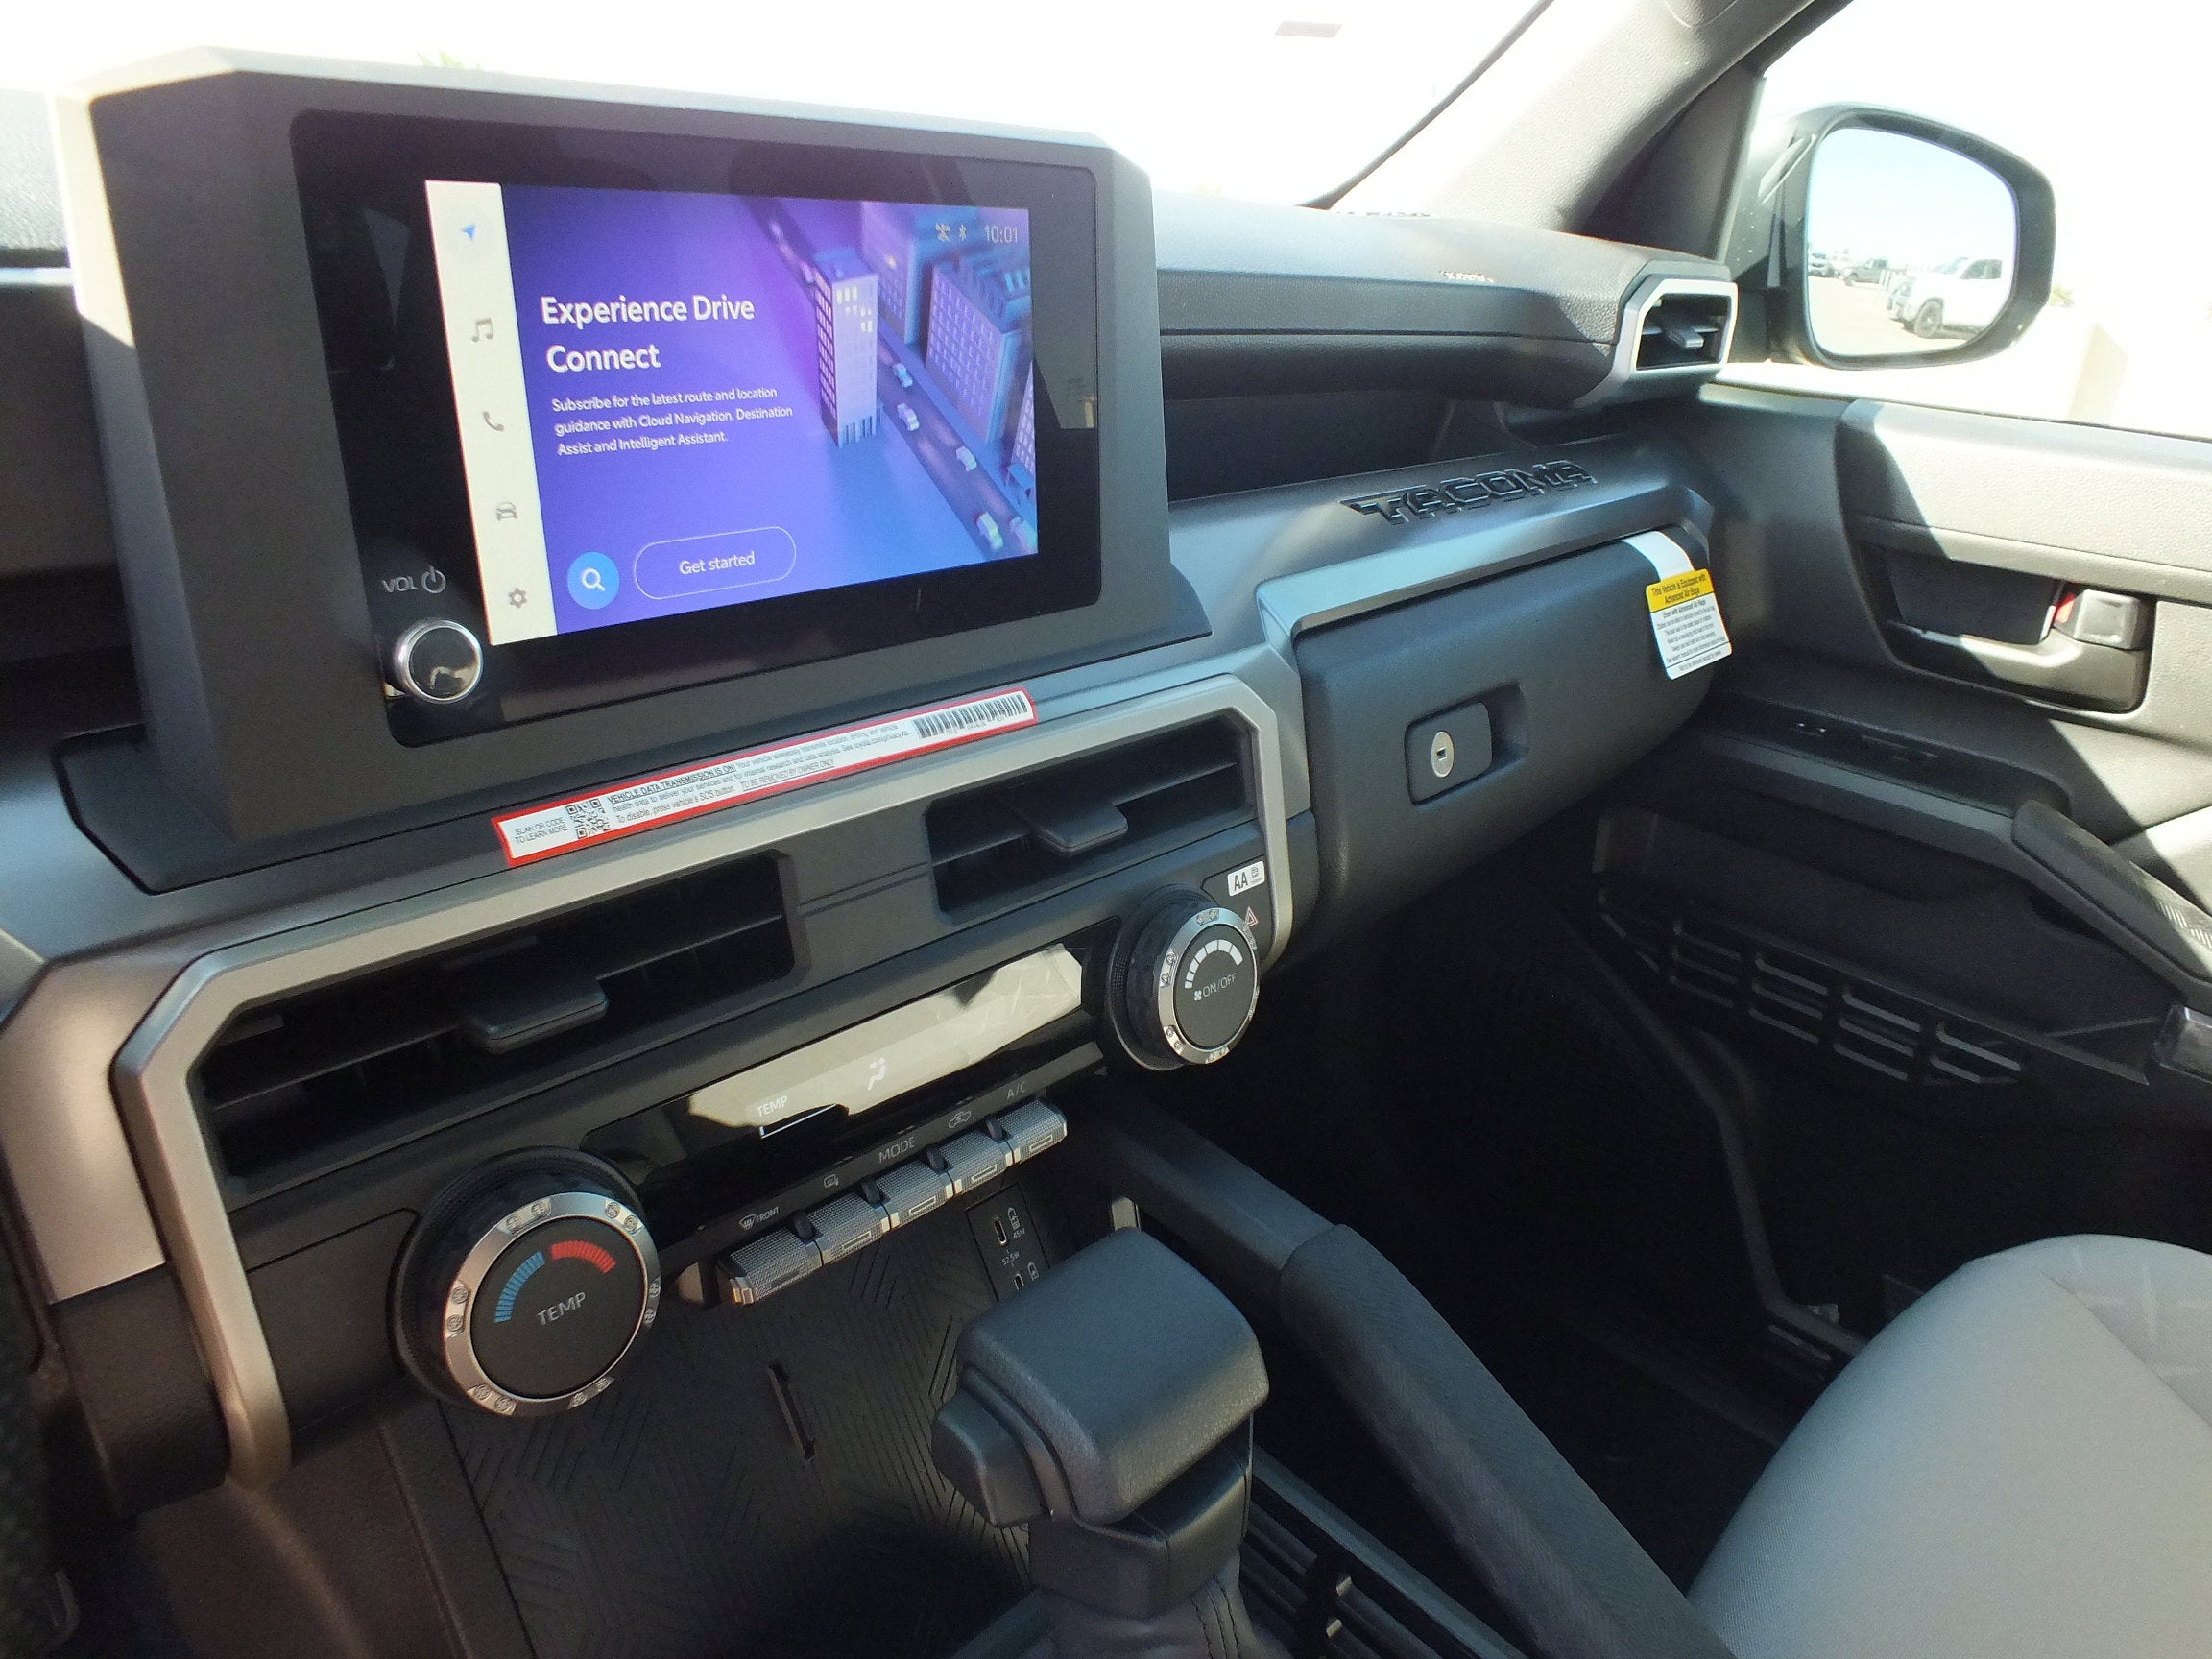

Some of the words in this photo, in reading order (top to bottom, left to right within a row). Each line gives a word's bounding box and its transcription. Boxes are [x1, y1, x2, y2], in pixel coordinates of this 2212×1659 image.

[984, 224, 1018, 244] 10:01
[541, 294, 687, 329] Experience
[692, 294, 755, 320] Drive
[546, 344, 661, 373] Connect
[552, 395, 611, 412] Subscribe
[613, 395, 629, 408] for
[631, 394, 650, 407] the
[652, 391, 684, 404] latest
[685, 390, 713, 403] route
[715, 388, 735, 400] and
[737, 387, 778, 399] location
[554, 419, 611, 437] guidance
[613, 416, 637, 429] with
[638, 413, 672, 427] Cloud
[674, 409, 734, 425] Navigation,
[736, 406, 793, 421] Destination
[557, 440, 591, 456] Assist
[594, 438, 617, 452] and
[619, 433, 676, 450] Intelligent
[678, 431, 728, 445] Assistant.
[1337, 460, 1598, 525] TACOMA
[679, 558, 707, 576] Get
[709, 550, 756, 571] started
[381, 576, 418, 594] VOL
[607, 790, 641, 805] VEHICLE
[641, 784, 661, 797] DATA
[662, 771, 714, 790] TRANSMISSION
[615, 813, 626, 824] To
[699, 789, 714, 802] SOS
[515, 826, 535, 836] SCAN
[545, 816, 565, 828] CODE
[548, 824, 568, 835] MORE
[1234, 871, 1248, 891] AA
[1202, 972, 1236, 998] ON/OFF
[1006, 1081, 1027, 1100] A/C
[756, 1094, 789, 1118] TEMP
[878, 1135, 916, 1164] MODE
[755, 1205, 781, 1224] FRONT
[537, 1291, 586, 1326] TEMP
